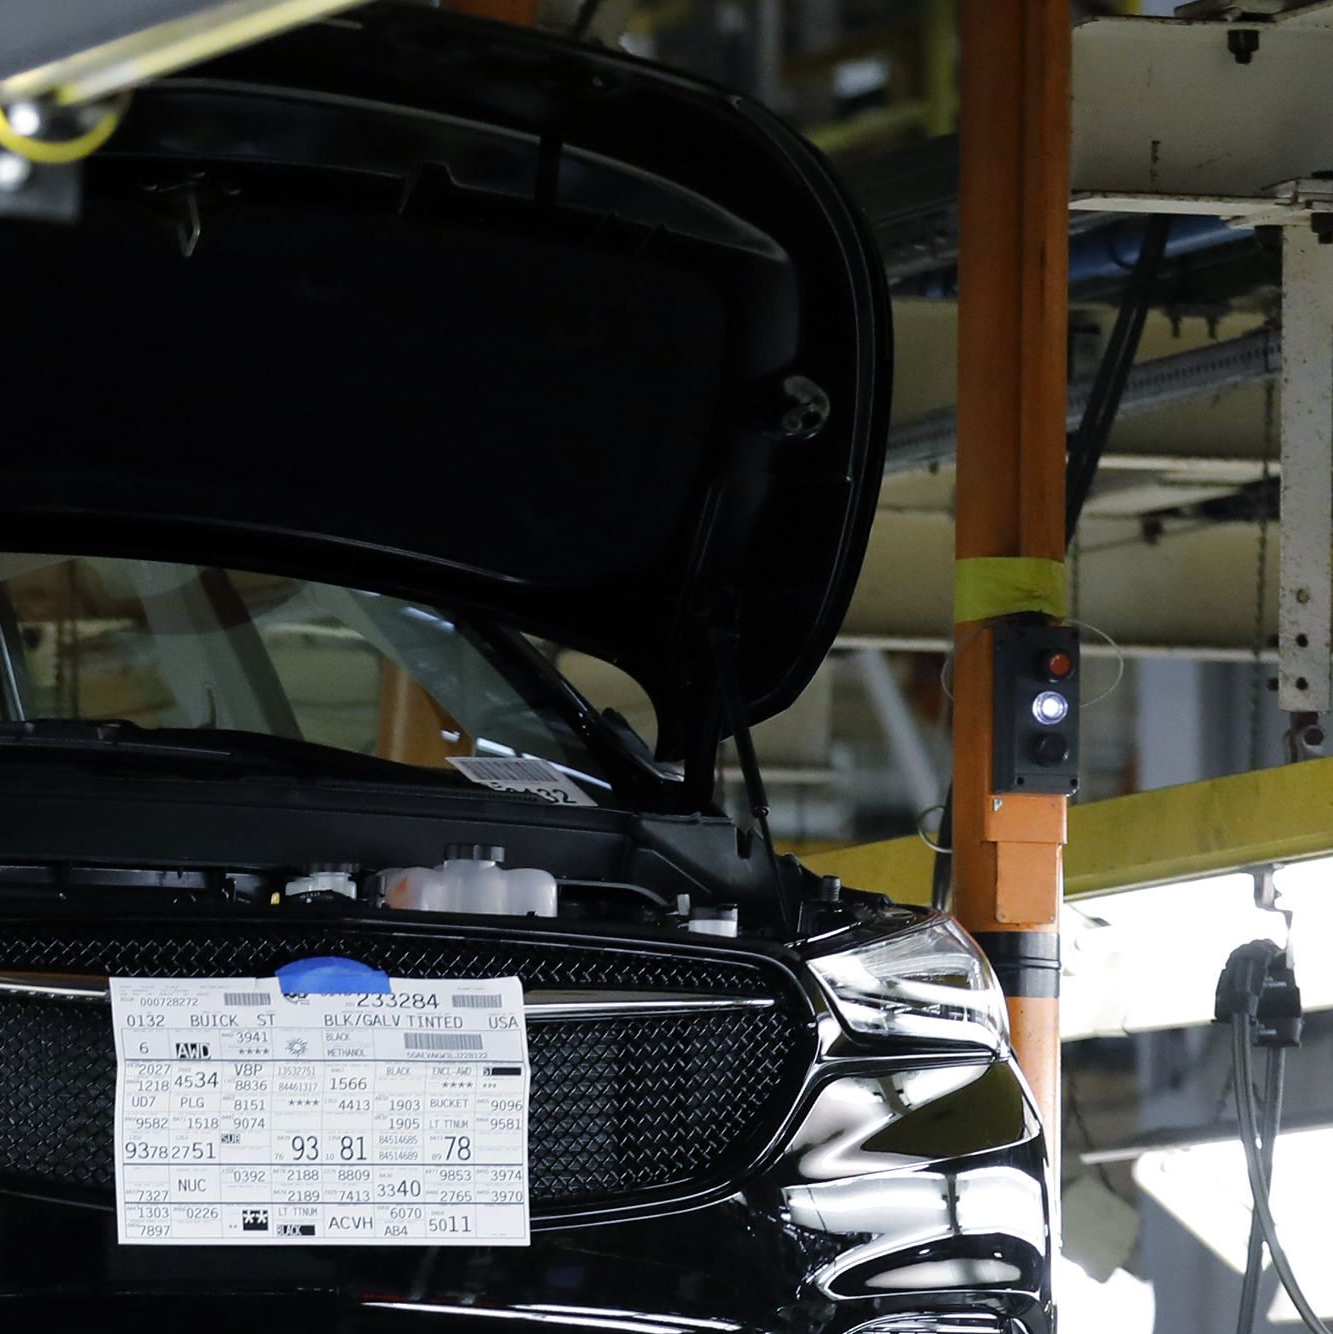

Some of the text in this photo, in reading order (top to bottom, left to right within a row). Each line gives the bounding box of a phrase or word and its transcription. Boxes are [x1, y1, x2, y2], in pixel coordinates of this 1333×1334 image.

[140, 996, 199, 1007] 000728272
[357, 992, 439, 1009] 233284
[126, 1013, 519, 1029] 0132 BUICK ST BLK/GALV TINTED USA
[236, 1031, 269, 1043] 3941
[325, 1032, 351, 1042] BLACK
[139, 1042, 149, 1054] 6
[175, 1042, 212, 1060] AWD
[327, 1048, 367, 1058] METHANOL
[138, 1064, 171, 1076] 2027
[233, 1063, 263, 1076] V8P
[277, 1066, 316, 1076] 13532751
[386, 1066, 411, 1076] BLACK
[432, 1066, 472, 1076] ENCL-AWD
[138, 1080, 170, 1092] 1218
[174, 1072, 219, 1088] 4534
[235, 1080, 268, 1091] 8836
[329, 1077, 368, 1091] 1566
[131, 1096, 156, 1108] UD7
[180, 1097, 205, 1108] PLG
[233, 1099, 266, 1111] 8151
[338, 1099, 371, 1111] 4413
[389, 1100, 421, 1111] 1903
[429, 1098, 469, 1108] BUCKET
[491, 1100, 523, 1112] 9096
[135, 1118, 169, 1130] 9582
[187, 1118, 219, 1130] 1518
[233, 1118, 266, 1130] 9074
[388, 1118, 421, 1130] 1905
[429, 1120, 440, 1129] LT
[489, 1118, 522, 1130] 9581
[125, 1142, 169, 1160] 9378
[171, 1142, 217, 1160] 2751
[291, 1135, 319, 1162] 93
[339, 1135, 367, 1162] 81
[443, 1136, 472, 1162] 78
[274, 1153, 285, 1161] 76
[325, 1153, 335, 1161] 10
[233, 1170, 266, 1182] 0392
[287, 1169, 320, 1182] 2188
[337, 1169, 371, 1182] 8809
[439, 1170, 473, 1182] 9853
[491, 1170, 523, 1182] 3974
[177, 1178, 207, 1192] NUC
[377, 1179, 422, 1198] 3340
[138, 1190, 170, 1202] 7327
[287, 1190, 321, 1202] 2189
[339, 1190, 371, 1202] 7413
[440, 1190, 473, 1202] 2765
[491, 1190, 523, 1202] 3970
[139, 1207, 170, 1219] 1303
[186, 1207, 219, 1219] 0226
[278, 1207, 289, 1217] LT
[389, 1207, 423, 1220] 6070
[328, 1216, 374, 1230] ACVH
[429, 1215, 473, 1233] 5011
[140, 1225, 171, 1237] 7897
[383, 1225, 409, 1237] AB4
